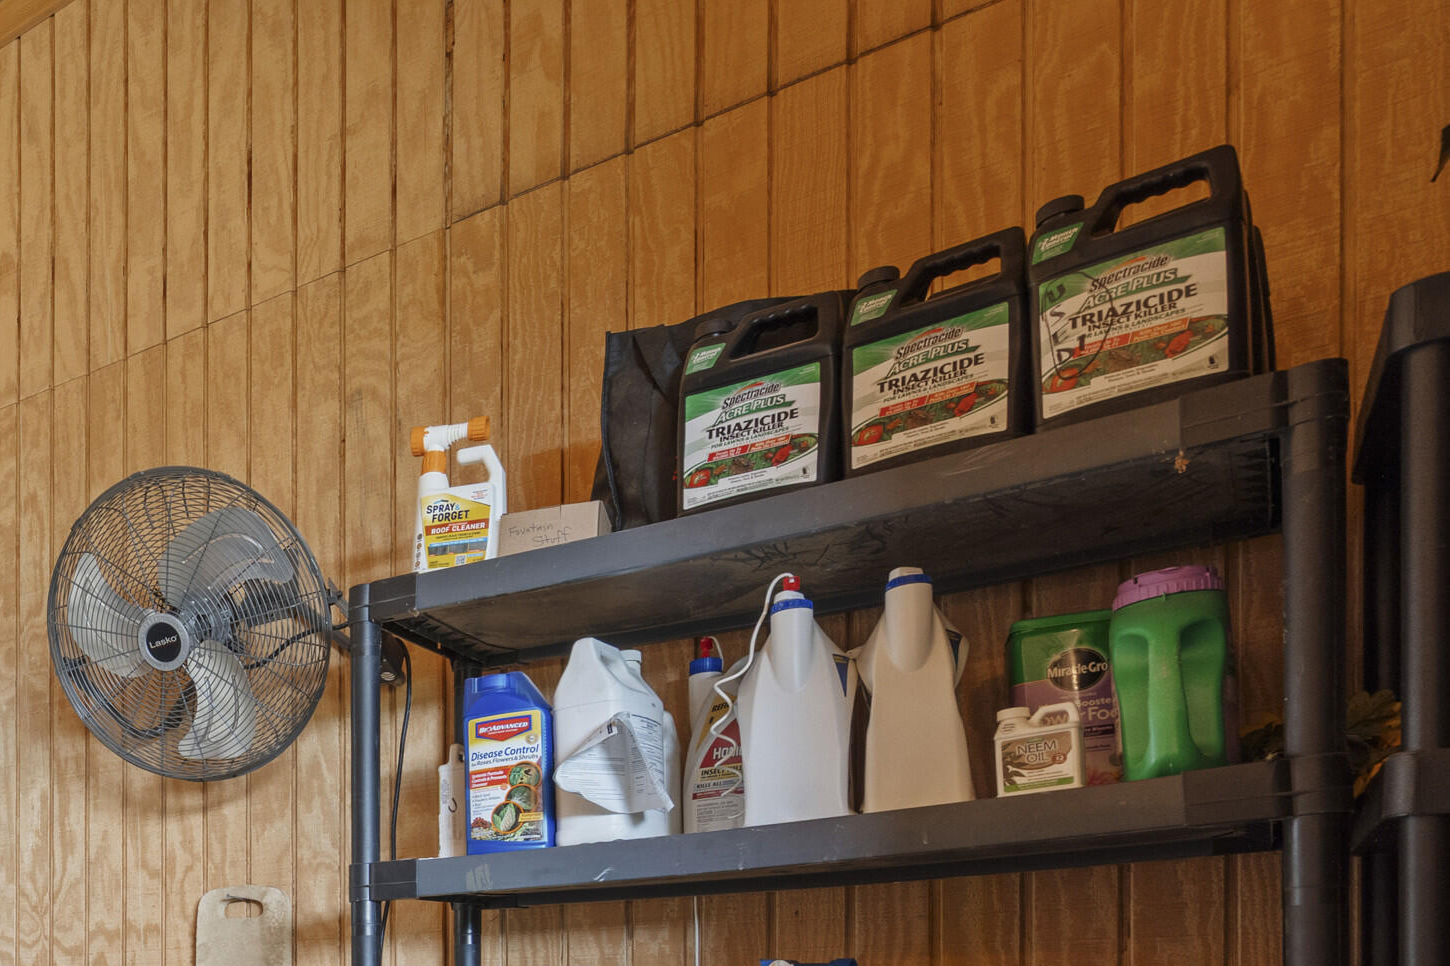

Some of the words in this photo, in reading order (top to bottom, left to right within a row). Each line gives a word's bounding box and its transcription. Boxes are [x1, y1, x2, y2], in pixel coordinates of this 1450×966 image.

[1090, 255, 1168, 293] Spectracide
[1079, 284, 1129, 313] ACRE
[1131, 268, 1178, 293] PLUS
[1069, 284, 1198, 330] TRIAZICIDE
[1087, 315, 1131, 331] INSECT
[1134, 302, 1177, 319] KILLER
[1131, 308, 1186, 327] LANDSCAPES
[895, 327, 962, 360] Spectracide
[886, 351, 930, 379] ACRE
[931, 339, 969, 359] PLUS
[877, 353, 985, 393] TRIAZICIDE
[893, 380, 929, 395] INSECT
[931, 369, 967, 384] KILLER
[722, 383, 782, 410] Spectracide
[706, 408, 799, 439] TRIAZICIDE
[714, 404, 749, 427] ACRE
[751, 394, 786, 410] PLUS
[719, 429, 752, 442] INSECT
[753, 421, 784, 434] KILLER
[426, 503, 455, 514] SPRAY
[432, 510, 470, 523] FORGET
[431, 526, 450, 535] ROOF
[451, 522, 486, 532] CLEANER
[149, 635, 177, 649] Lasko
[471, 749, 503, 762] Disease
[504, 744, 540, 756] Control
[1016, 740, 1057, 756] NEEM
[1026, 751, 1048, 763] OIL
